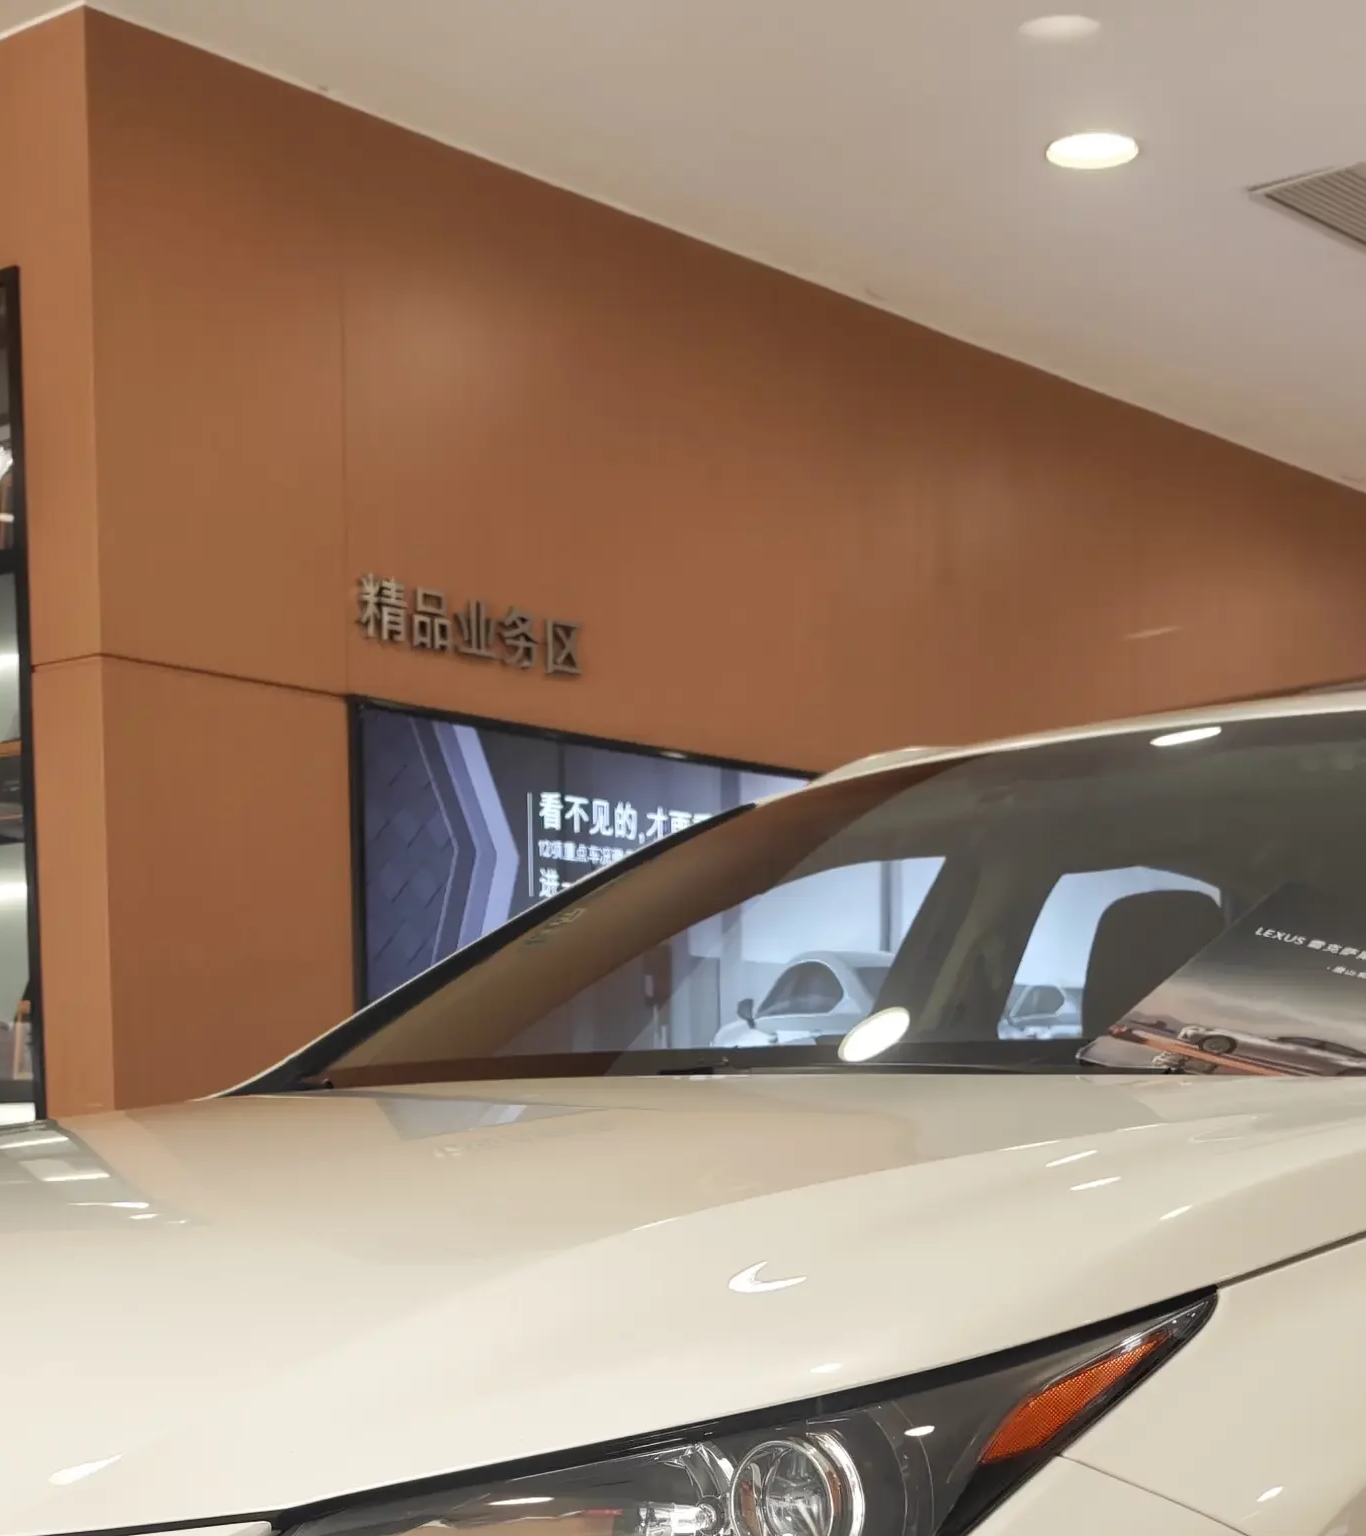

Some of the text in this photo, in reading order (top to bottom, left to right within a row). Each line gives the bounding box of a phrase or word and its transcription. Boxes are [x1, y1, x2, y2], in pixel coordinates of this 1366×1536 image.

[358, 572, 583, 676] 精品业务区
[1254, 926, 1306, 946] LEXUS
